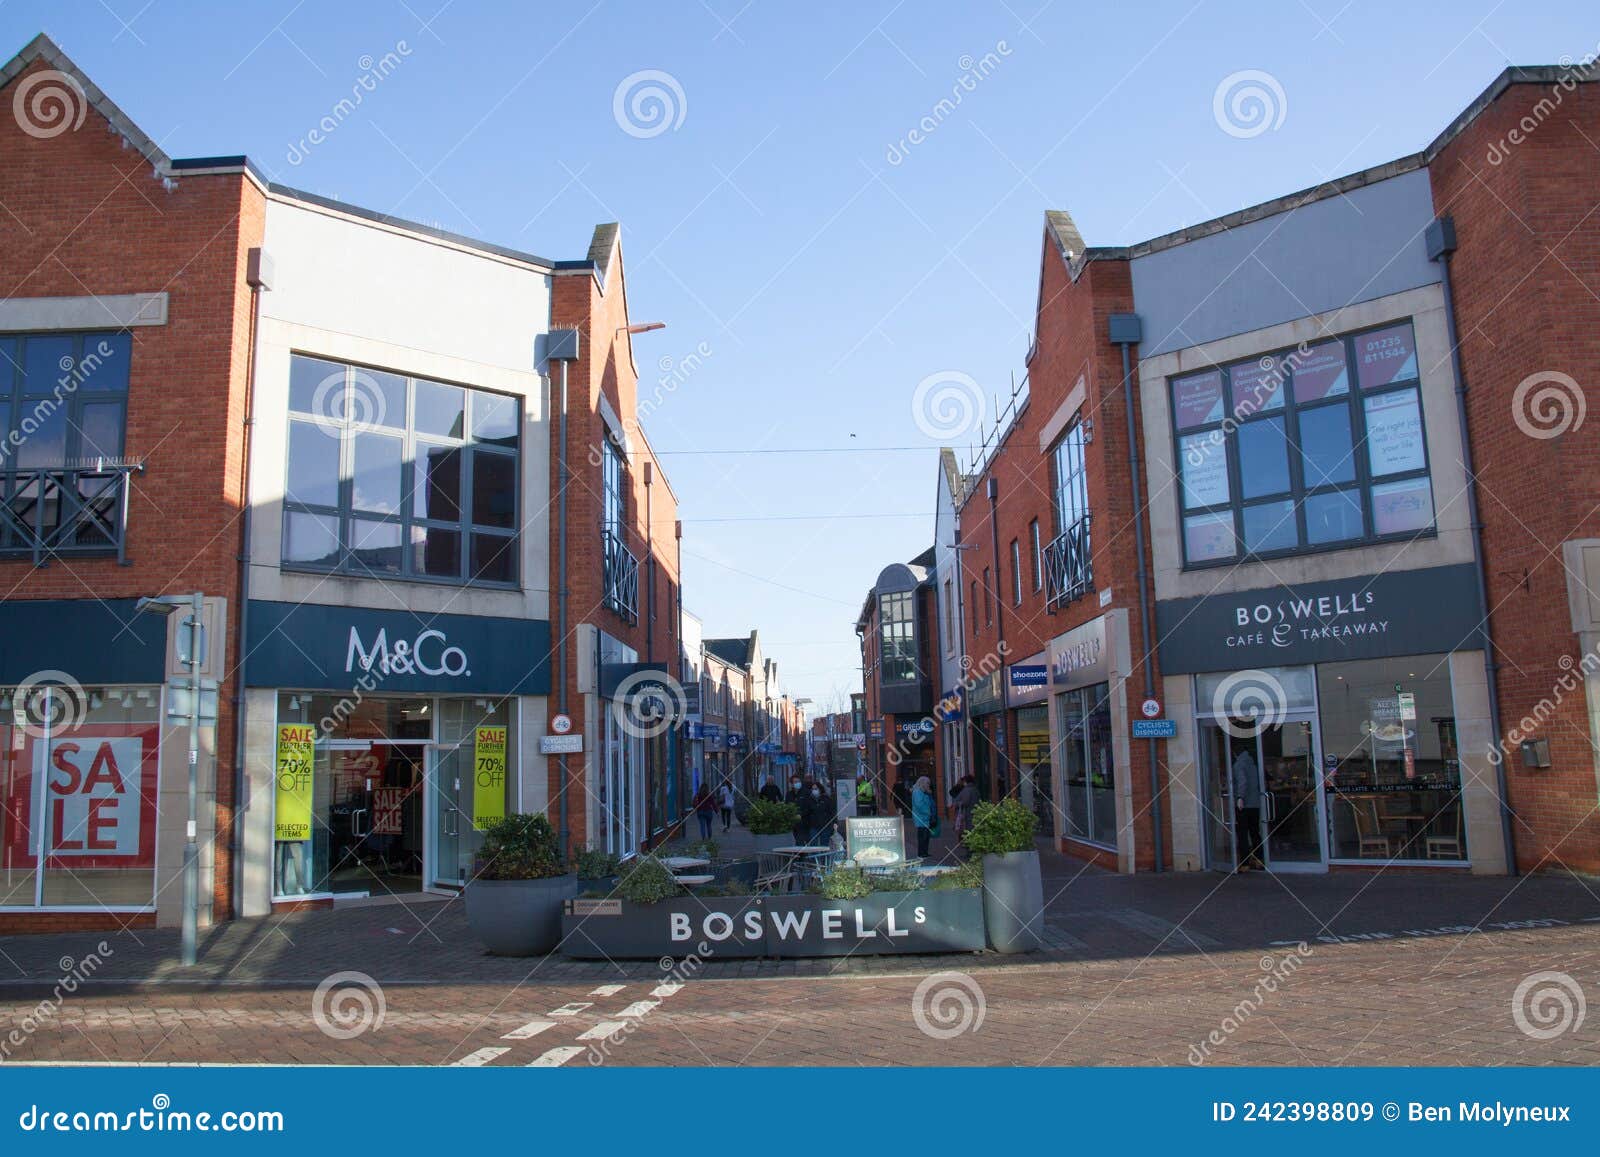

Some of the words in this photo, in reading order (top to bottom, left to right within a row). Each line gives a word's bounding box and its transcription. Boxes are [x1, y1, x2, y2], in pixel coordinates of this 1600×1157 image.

[1367, 336, 1401, 351] 01235
[1226, 631, 1265, 647] CAFÉ
[1300, 621, 1389, 641] TAKEAWAY
[903, 722, 930, 731] GREGGS
[280, 728, 313, 742] SALE
[479, 730, 505, 743] SALE
[279, 742, 312, 750] FURTHER
[279, 760, 311, 774] 70%
[479, 758, 504, 771] 70%
[278, 774, 311, 791] OFF
[477, 771, 504, 788] OFF
[374, 789, 402, 810] SALE
[374, 811, 402, 832] SALE
